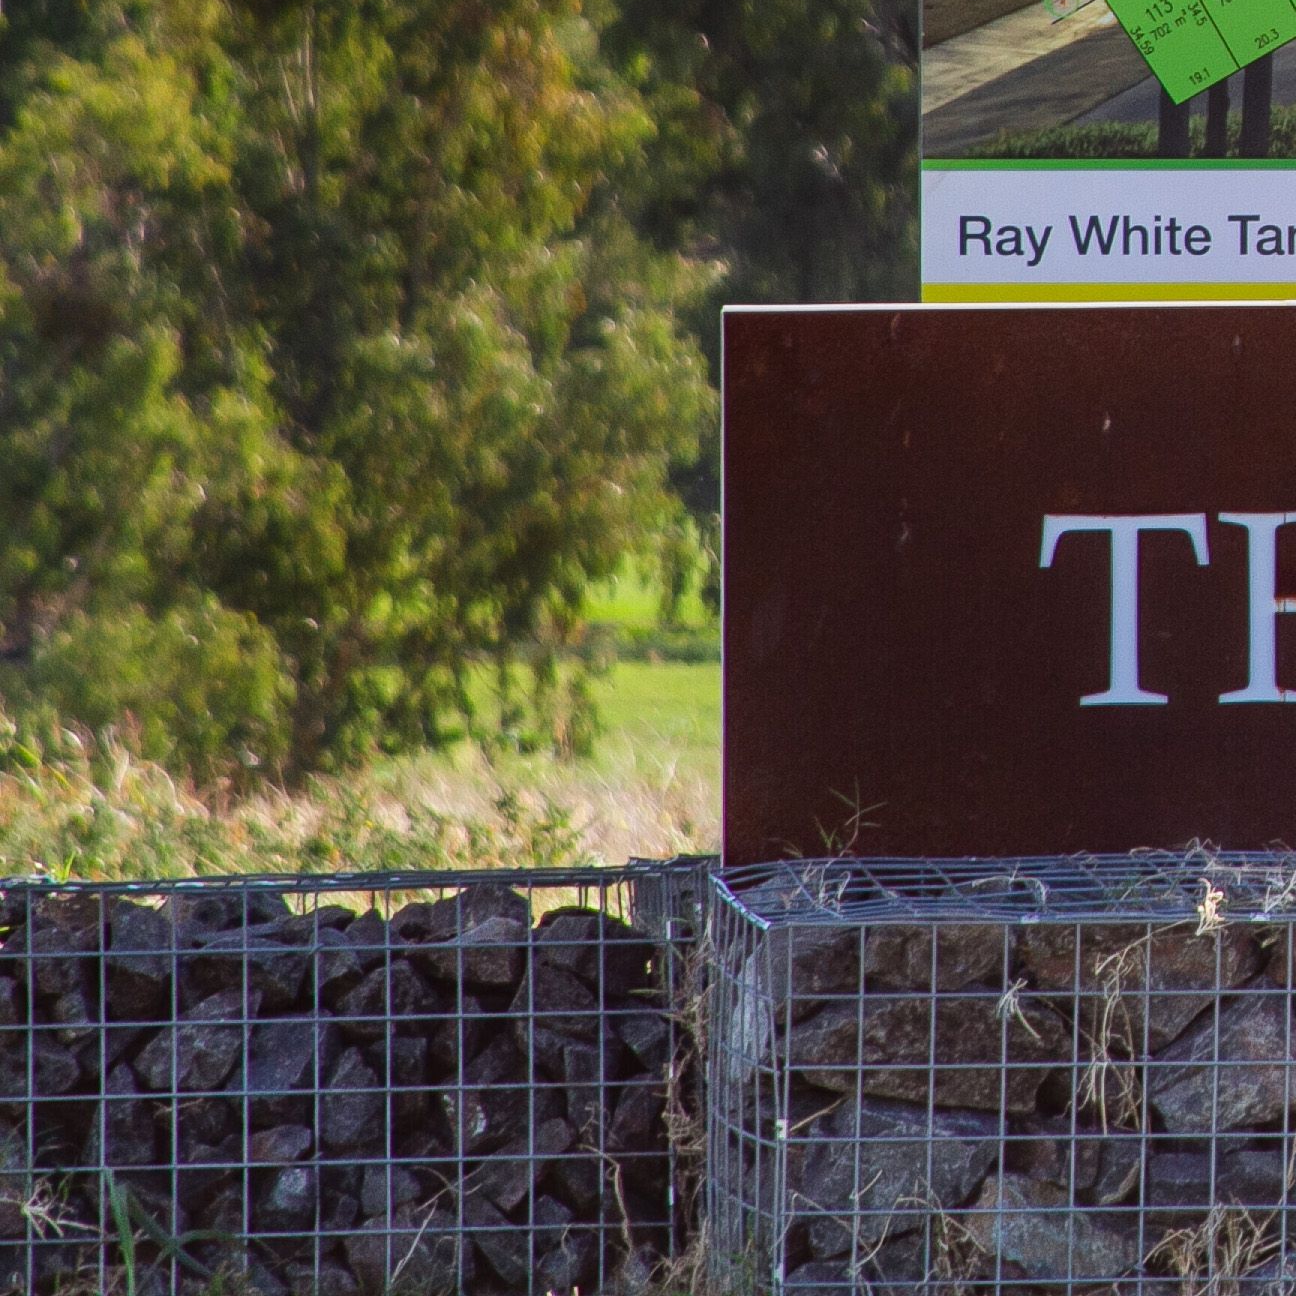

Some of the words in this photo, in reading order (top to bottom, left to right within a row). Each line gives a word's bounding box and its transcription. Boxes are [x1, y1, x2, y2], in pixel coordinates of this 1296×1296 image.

[1150, 23, 1173, 41] 702
[1254, 28, 1280, 49] 20.3
[958, 215, 1052, 266] Ray
[1069, 215, 1213, 257] White
